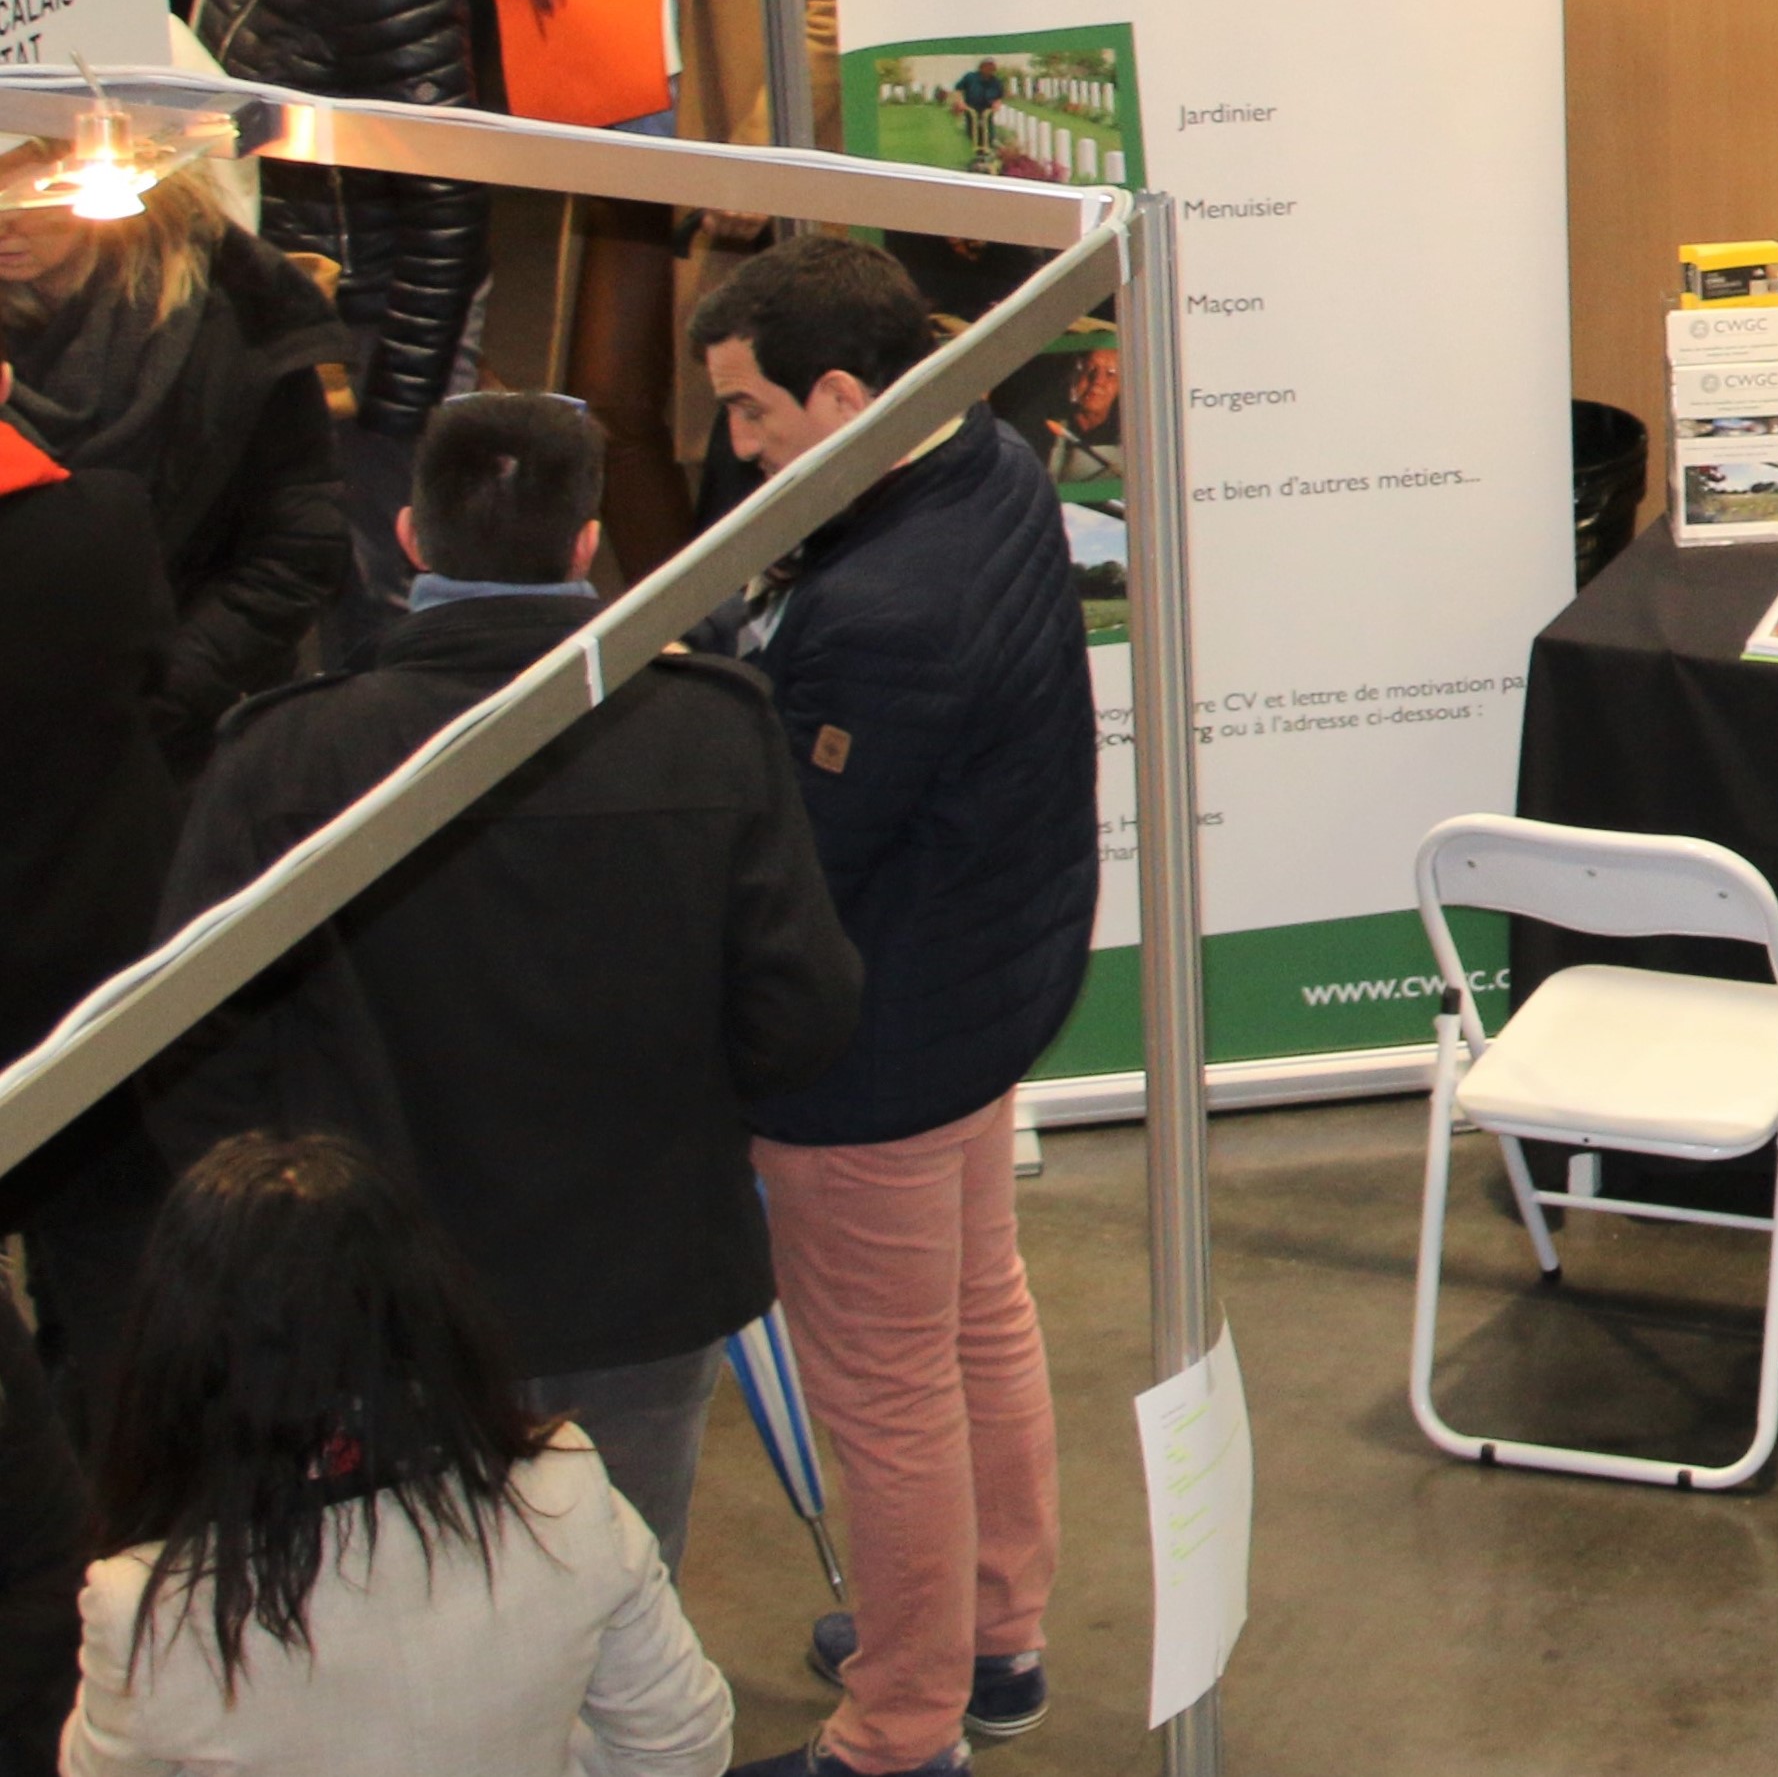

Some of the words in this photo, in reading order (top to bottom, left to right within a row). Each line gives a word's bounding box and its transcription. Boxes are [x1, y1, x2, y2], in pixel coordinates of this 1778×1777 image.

[1178, 102, 1278, 131] Jardinier
[1183, 197, 1298, 220] Menuisier
[1186, 293, 1265, 318] Maçon
[1714, 317, 1769, 334] CWGC
[1190, 386, 1297, 413] Forgeron
[1192, 483, 1217, 503] et
[1224, 480, 1271, 501] bien
[1279, 475, 1370, 498] d'autres
[1223, 691, 1258, 714] CV
[1264, 689, 1286, 709] et
[1291, 686, 1348, 708] lettre
[1355, 682, 1380, 703] de
[1386, 675, 1496, 702] motivation
[1220, 721, 1248, 739] ou
[1254, 717, 1266, 736] à
[1271, 712, 1360, 735] l'adresse
[1366, 703, 1472, 726] ci-dessous
